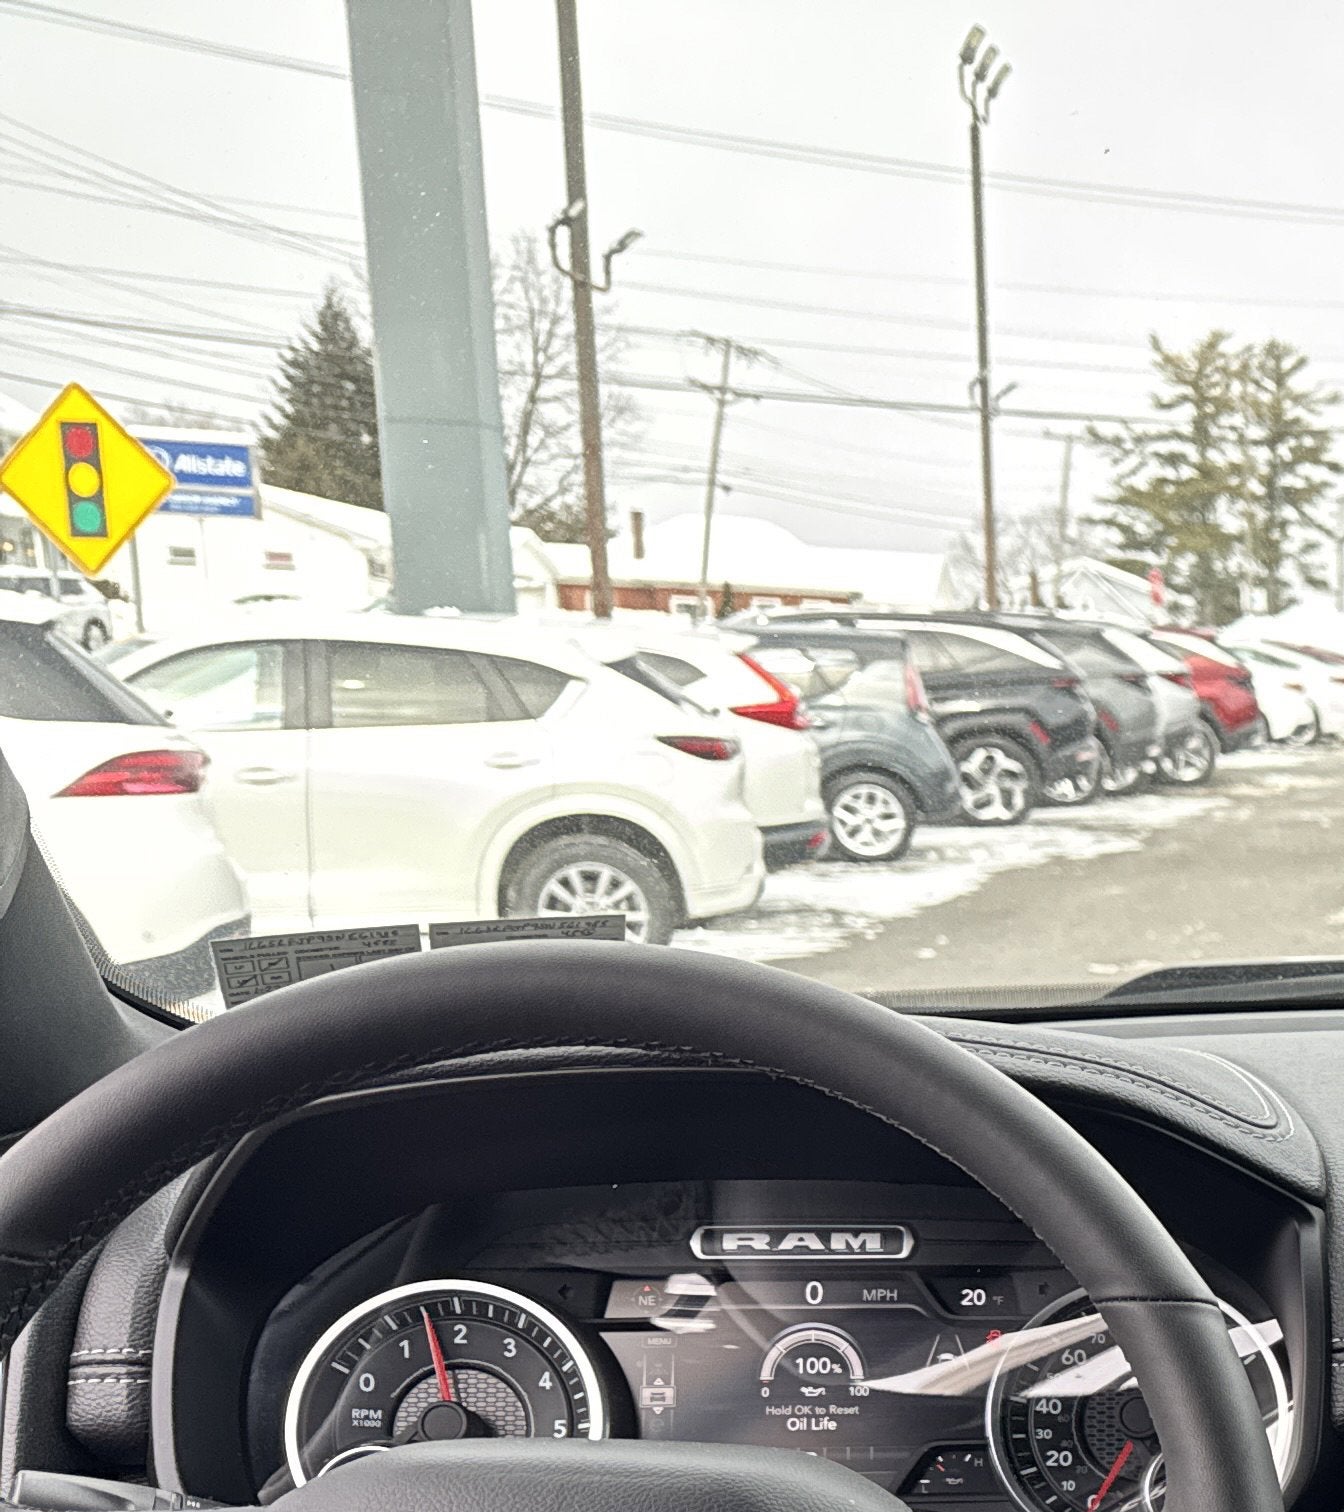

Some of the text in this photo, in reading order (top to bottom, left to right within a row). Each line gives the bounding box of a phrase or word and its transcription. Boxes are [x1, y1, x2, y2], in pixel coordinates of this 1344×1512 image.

[173, 453, 247, 478] Allstate
[721, 1232, 883, 1252] RAM
[638, 1295, 656, 1307] NE
[804, 1280, 824, 1306] 0
[862, 1289, 898, 1302] MPH
[960, 1289, 986, 1306] 20
[453, 1325, 467, 1345] 2
[647, 1337, 672, 1345] MENU
[398, 1340, 410, 1358] 1
[503, 1338, 516, 1357] 3
[795, 1357, 843, 1375] 100%
[1061, 1349, 1087, 1366] 60
[358, 1373, 375, 1393] 0
[538, 1371, 552, 1390] 4
[760, 1387, 769, 1398] 0
[848, 1386, 870, 1397] 100
[351, 1409, 382, 1419] RPM
[765, 1405, 860, 1416] Hold OK to Reset
[1035, 1399, 1062, 1415] 40
[553, 1420, 567, 1439] 5
[786, 1417, 838, 1431] Oil Life
[1035, 1429, 1053, 1440] 30
[1046, 1450, 1073, 1467] 20
[1061, 1480, 1076, 1491] 10
